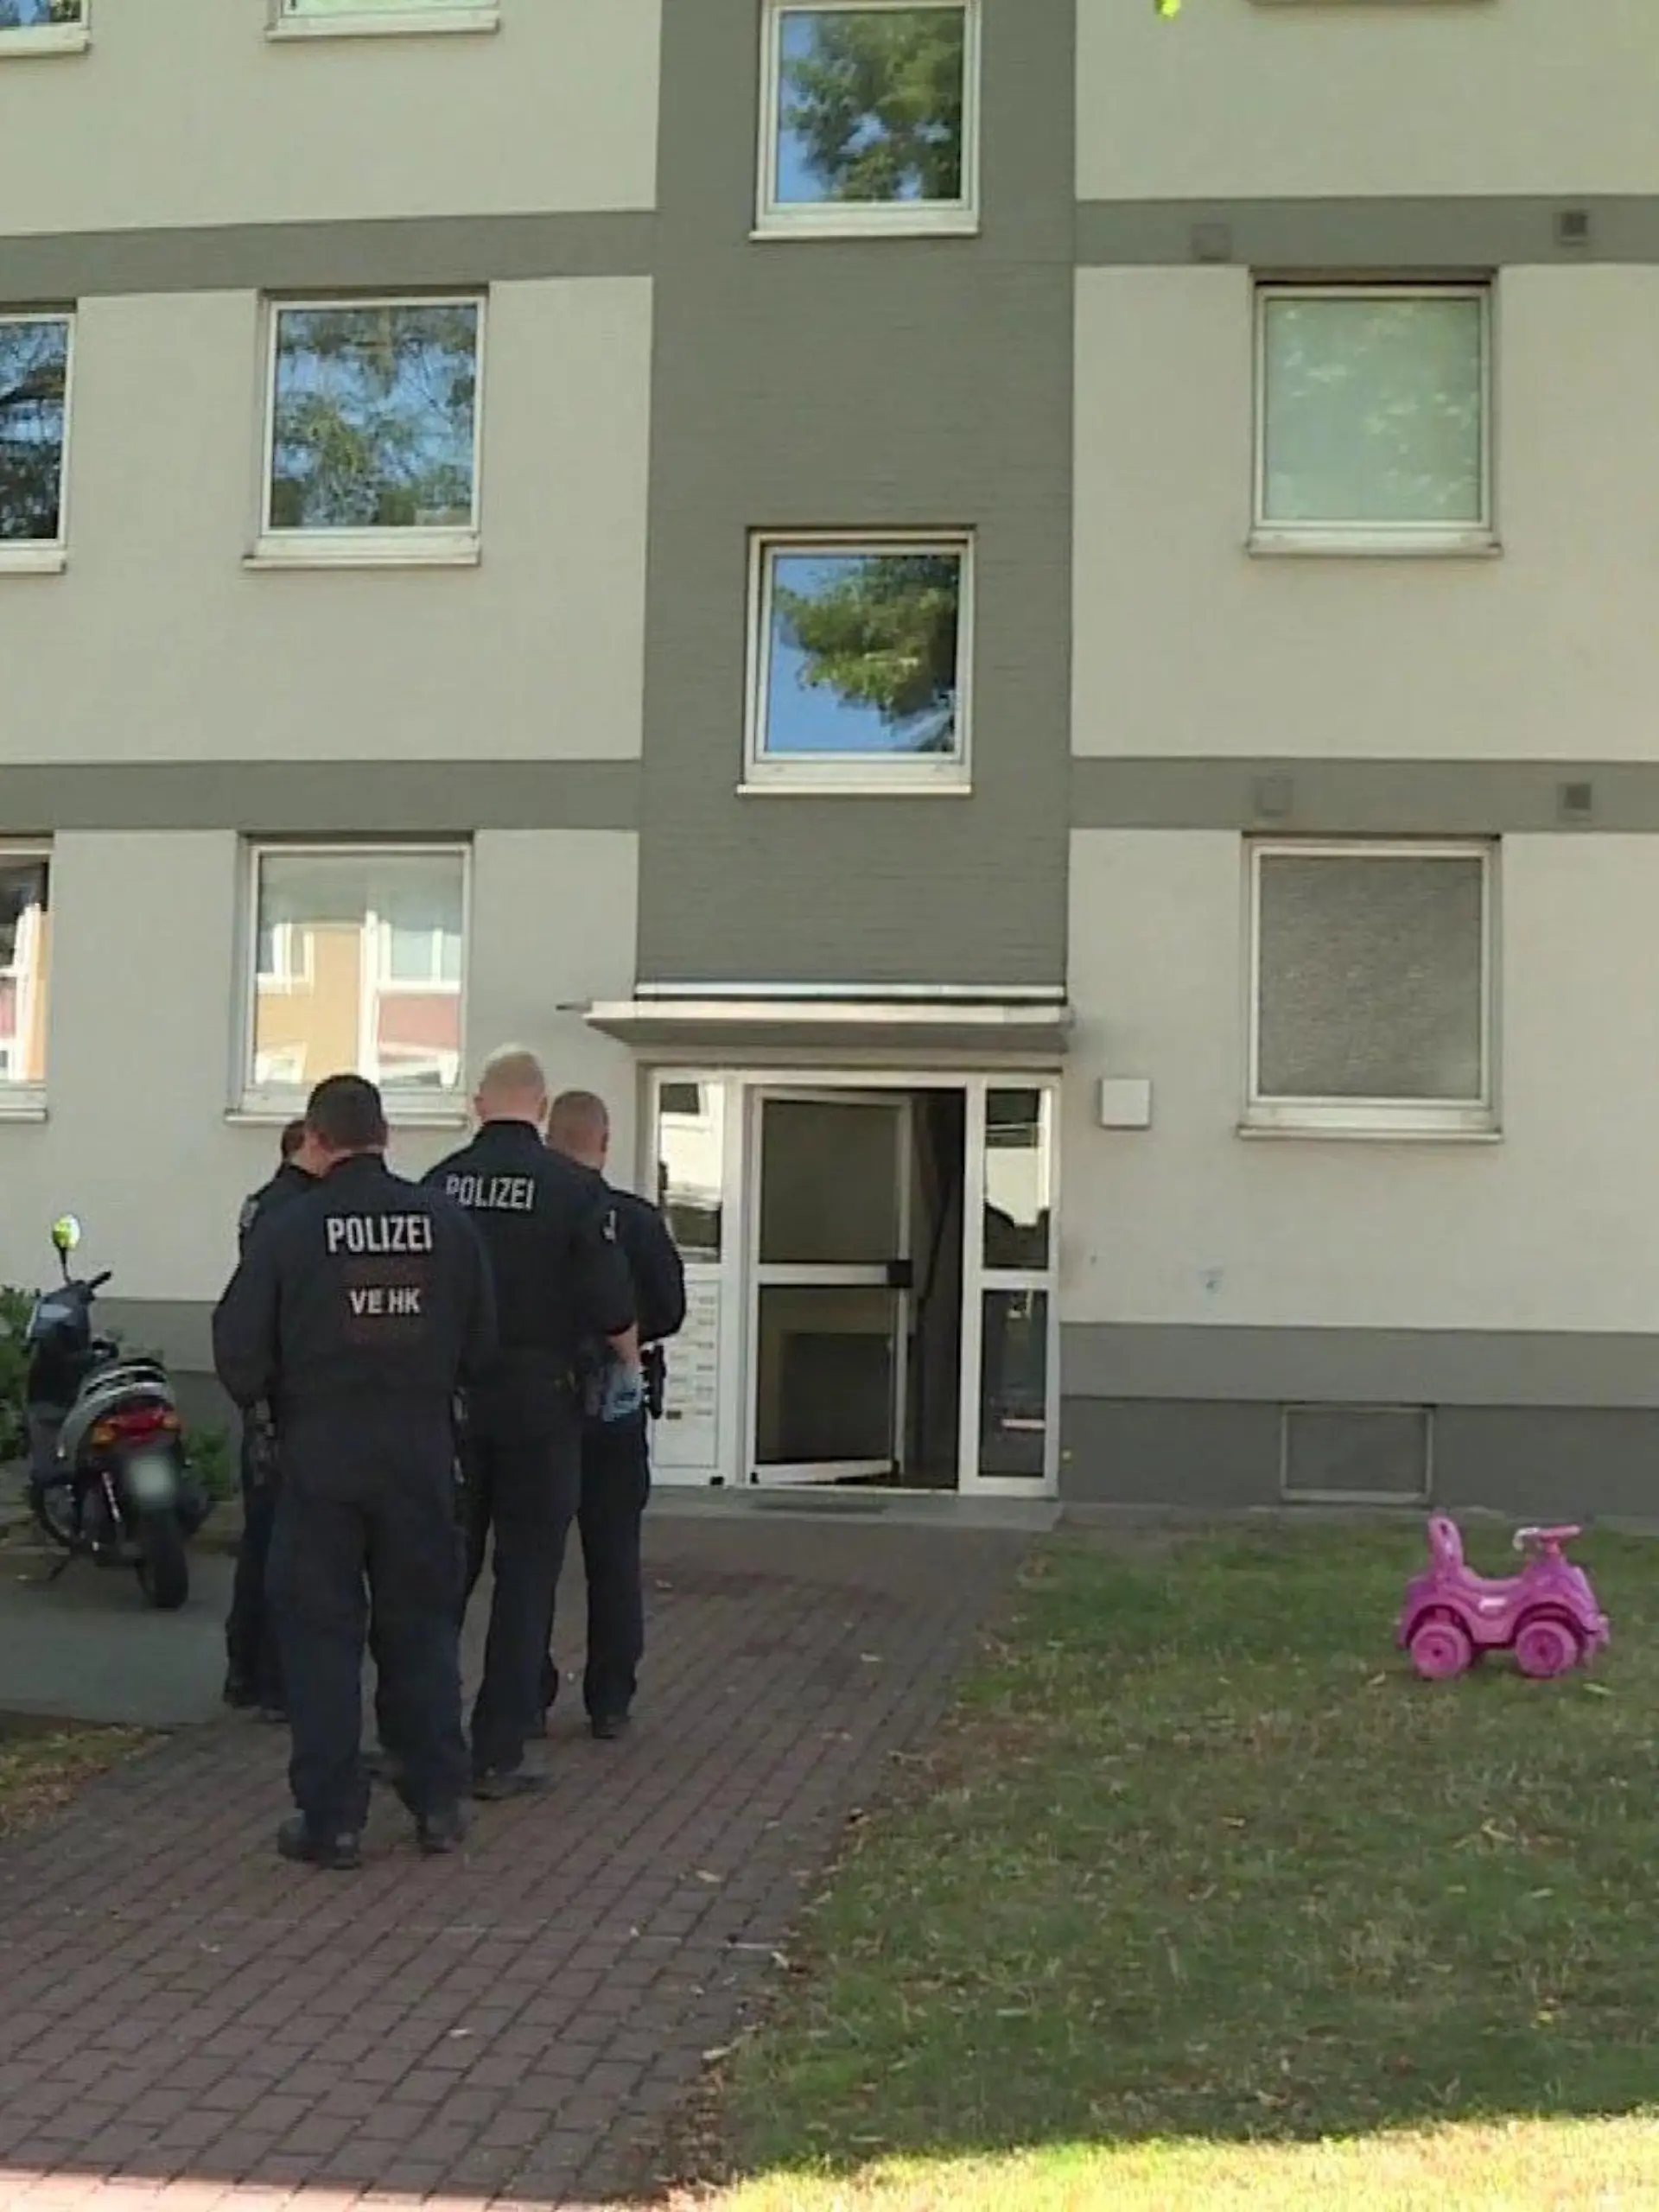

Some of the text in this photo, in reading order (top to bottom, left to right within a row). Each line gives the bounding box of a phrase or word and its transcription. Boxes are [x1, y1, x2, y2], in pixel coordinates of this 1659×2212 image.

[446, 1173, 534, 1209] POLIZEI
[327, 1217, 432, 1252] POLIZEI
[388, 1287, 421, 1313] HK
